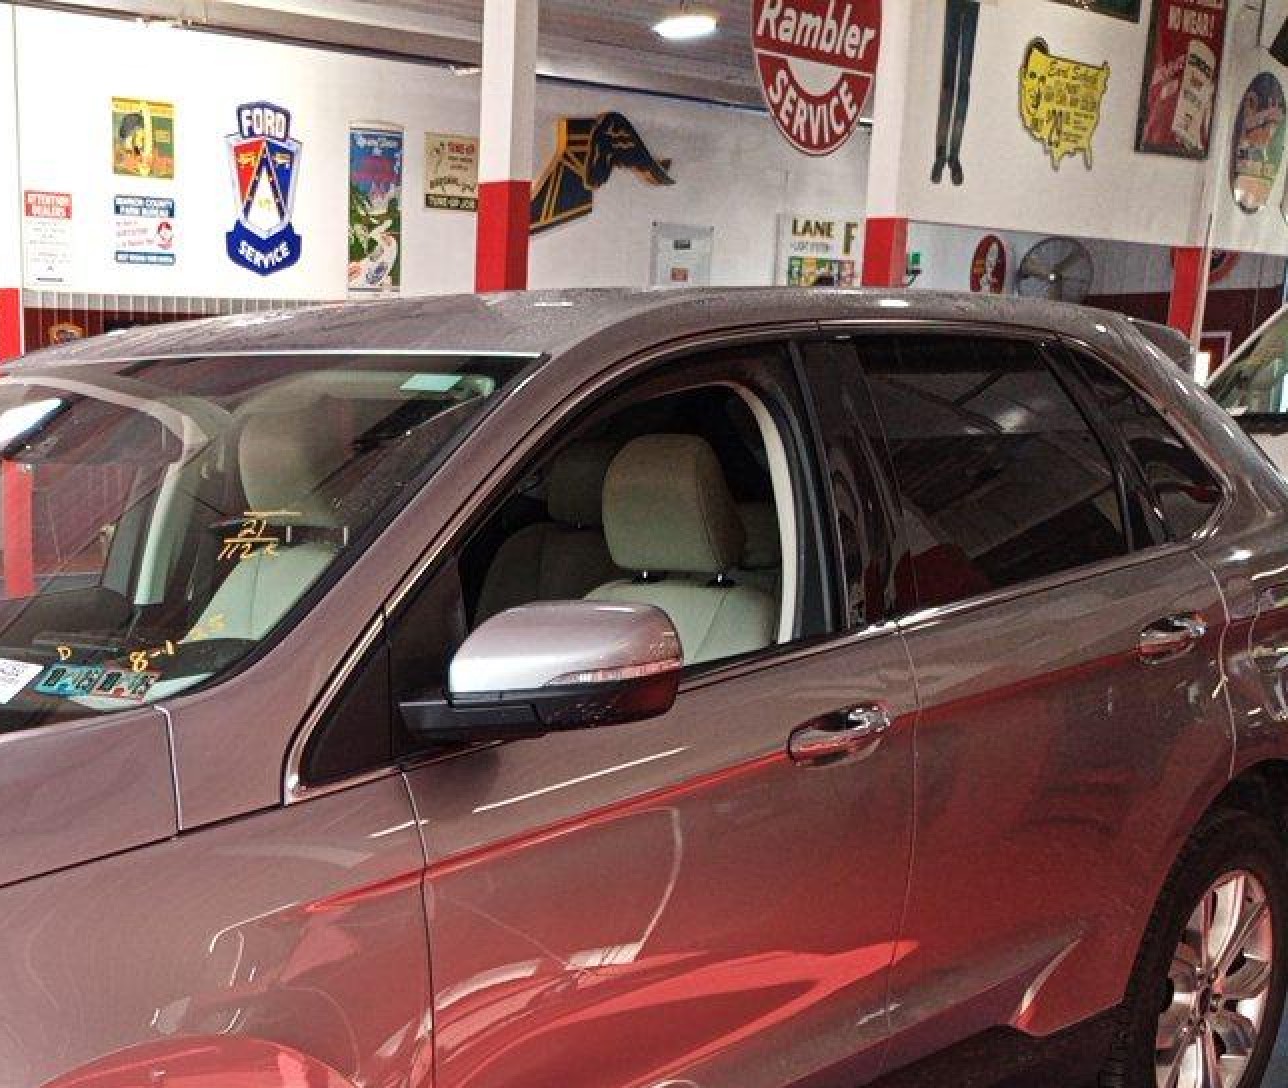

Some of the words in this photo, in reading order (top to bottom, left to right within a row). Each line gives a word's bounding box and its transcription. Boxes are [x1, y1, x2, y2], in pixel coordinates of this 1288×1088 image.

[756, 0, 876, 59] Rambler
[241, 107, 286, 139] FORD
[768, 69, 858, 145] SERVICE
[238, 239, 291, 269] SERVICE
[792, 217, 834, 239] LANE
[843, 221, 858, 255] F
